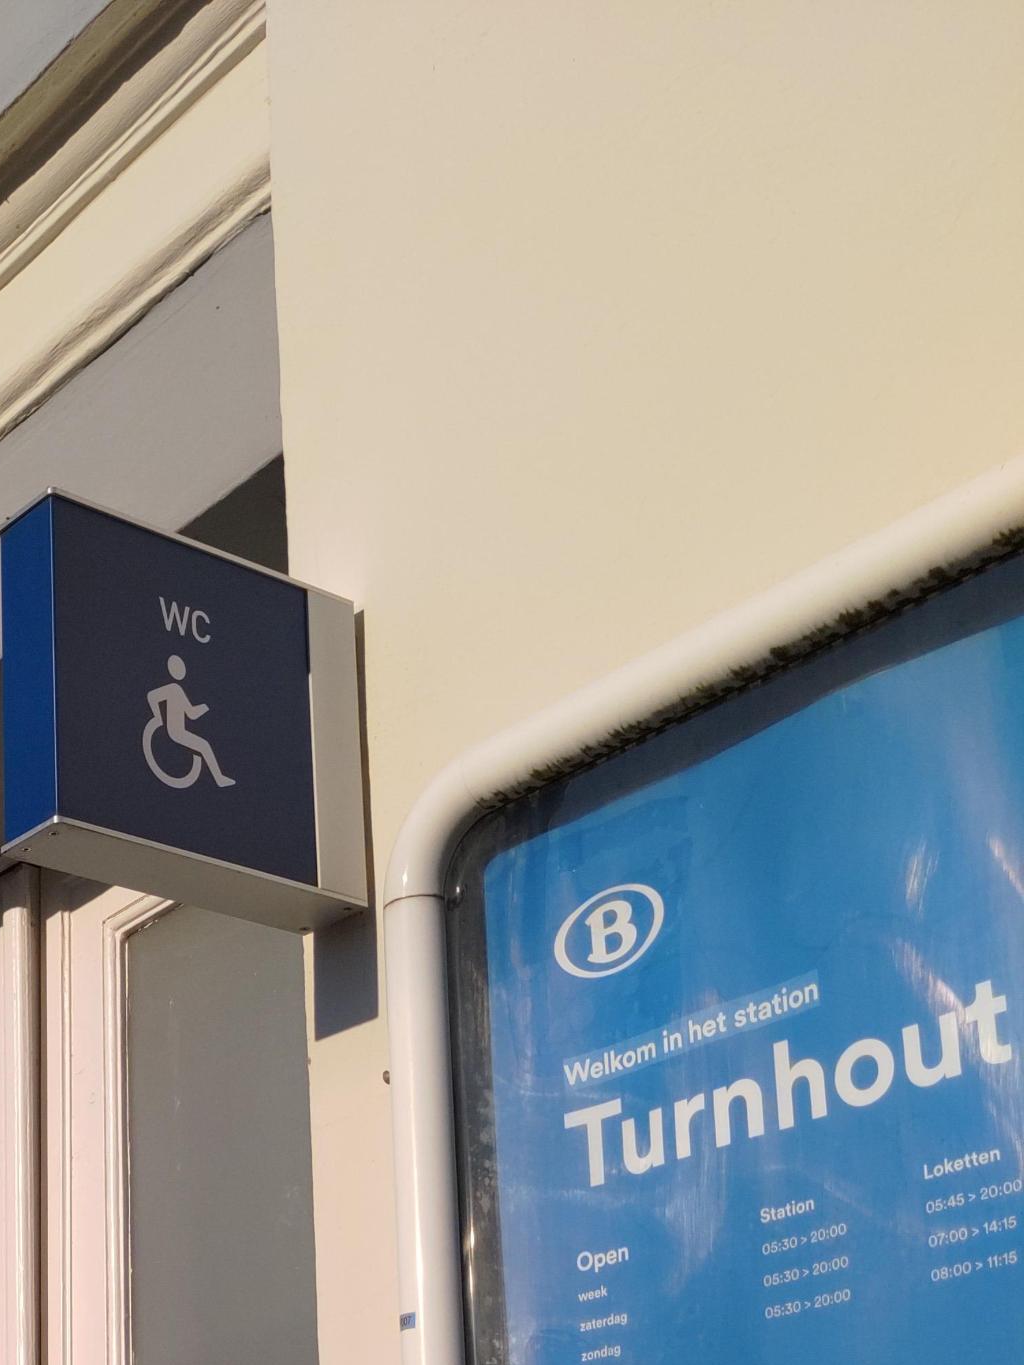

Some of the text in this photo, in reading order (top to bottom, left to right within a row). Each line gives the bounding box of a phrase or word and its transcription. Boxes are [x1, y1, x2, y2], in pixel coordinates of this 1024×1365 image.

[159, 596, 211, 643] WC
[585, 900, 637, 963] B
[563, 983, 818, 1086] Welkom in het station
[564, 979, 1012, 1187] Turnhout
[923, 1149, 1000, 1180] Loketten
[760, 1199, 815, 1224] Station
[926, 1193, 965, 1213] 05:45
[979, 1179, 1022, 1200] 20:00
[762, 1236, 798, 1255] 05:30
[810, 1223, 847, 1243] 20:00
[928, 1228, 968, 1248] 07:00
[983, 1216, 1017, 1234] 14:15
[577, 1246, 629, 1273] Open
[763, 1269, 800, 1287] 05:30
[812, 1256, 849, 1275] 20:00
[931, 1261, 972, 1281] 08:00
[987, 1250, 1017, 1269] 11:15
[578, 1284, 608, 1302] week
[765, 1301, 801, 1319] 05:30
[814, 1289, 851, 1308] 20:00
[580, 1313, 628, 1332] zaterdag
[581, 1345, 621, 1362] zondag
